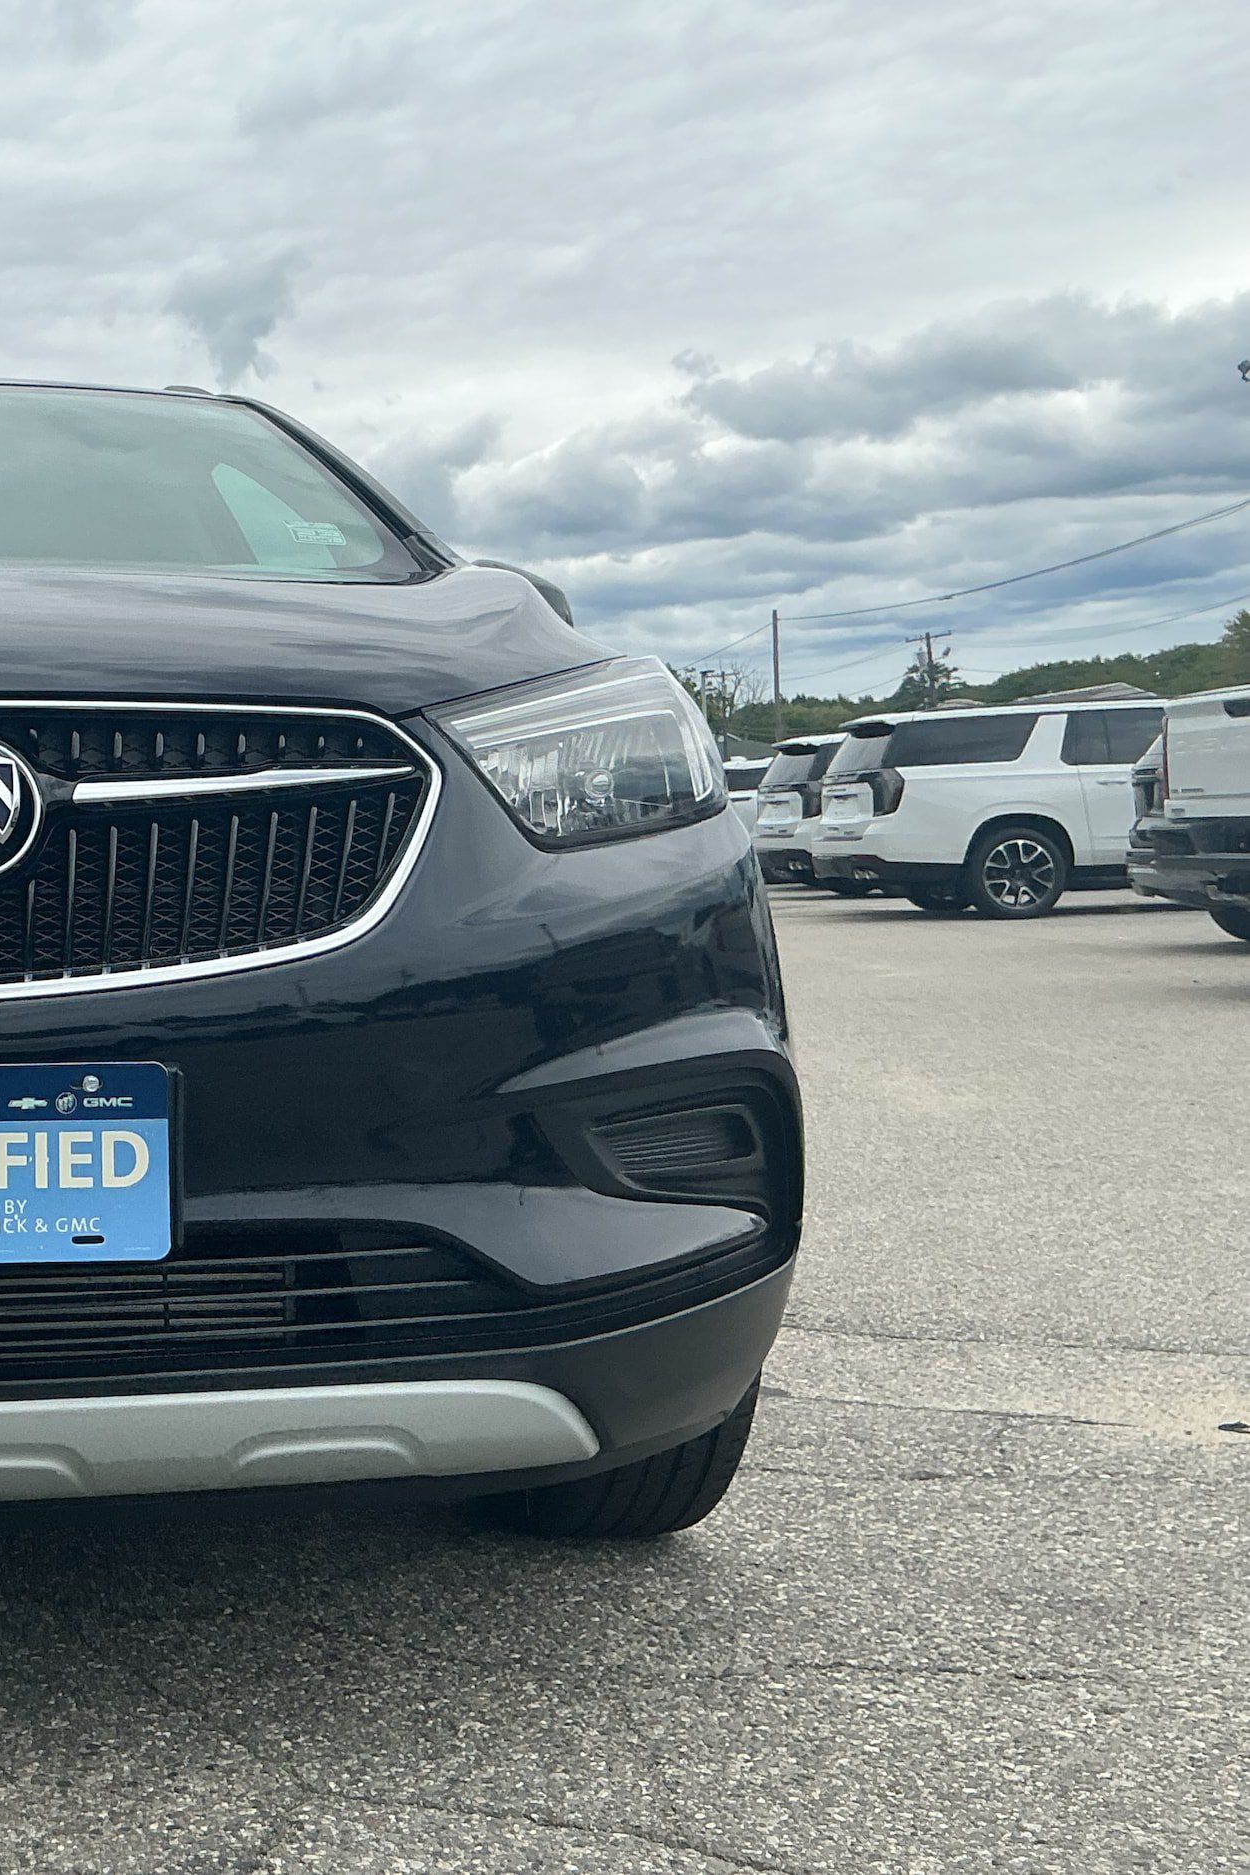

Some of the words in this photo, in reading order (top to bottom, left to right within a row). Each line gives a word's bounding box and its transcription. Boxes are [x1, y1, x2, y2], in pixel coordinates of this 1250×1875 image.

[83, 1096, 134, 1108] GMC
[3, 1199, 28, 1215] BY
[35, 1218, 49, 1234] &
[55, 1216, 101, 1233] GMC
